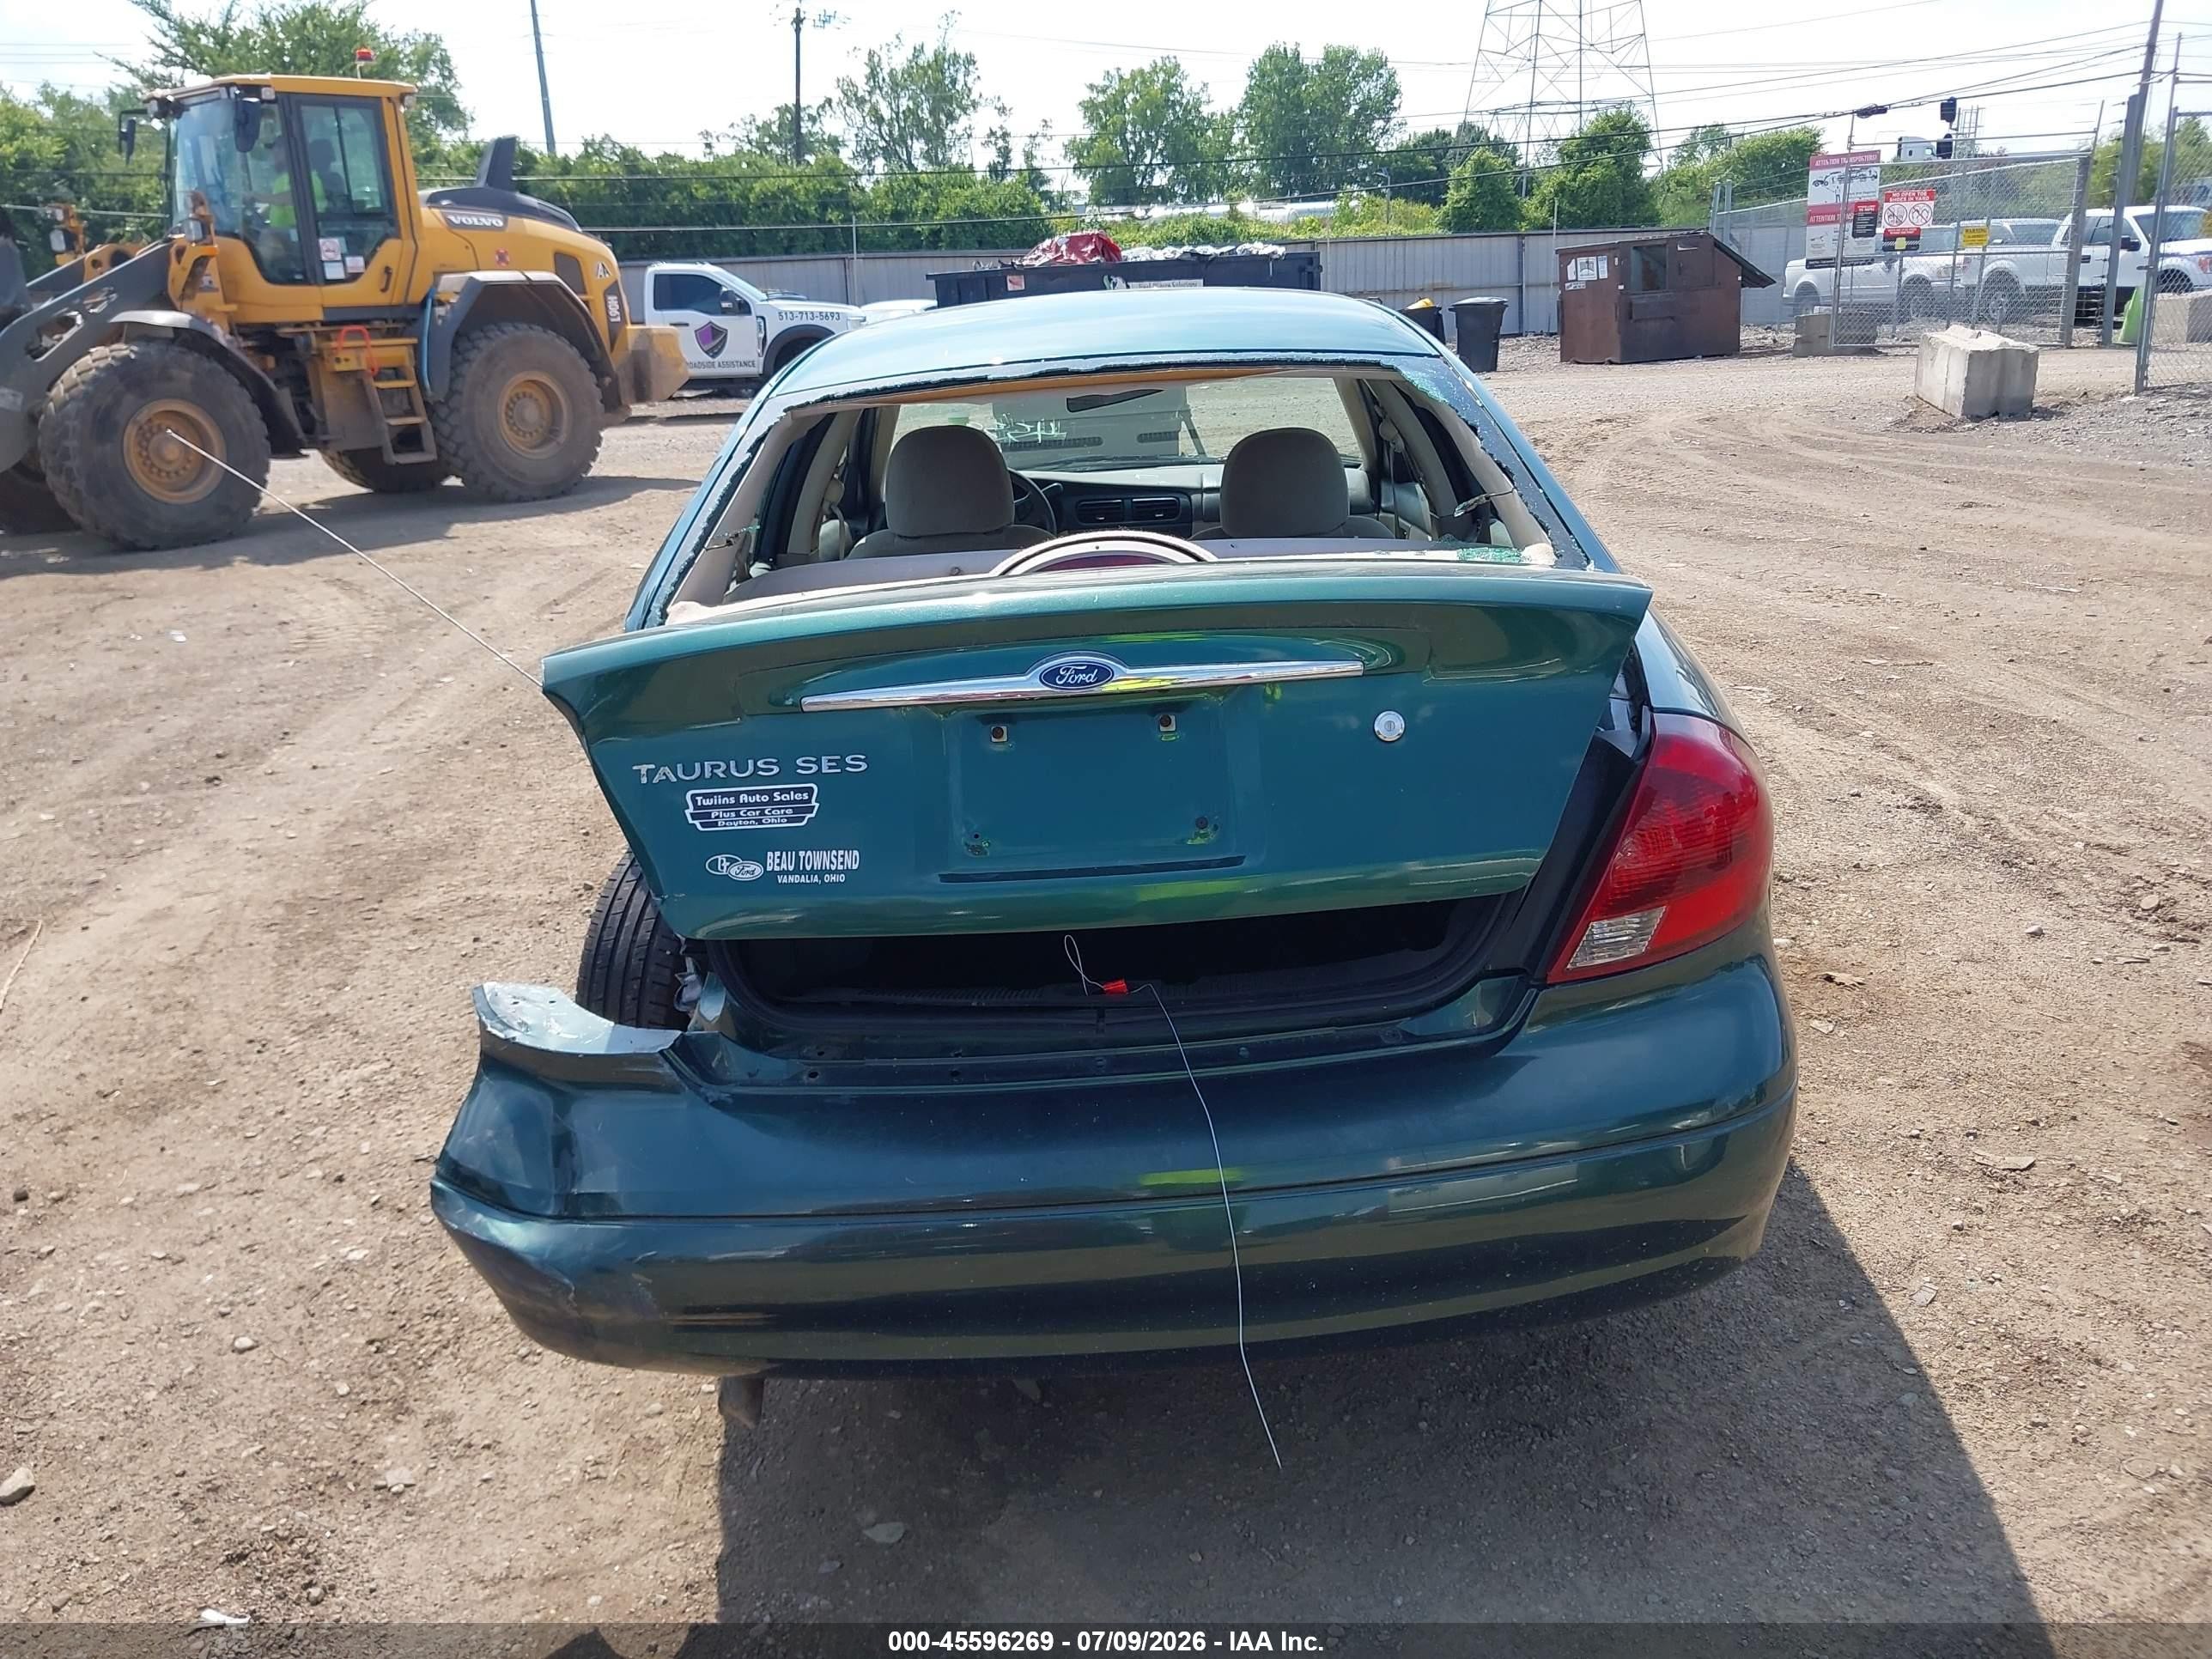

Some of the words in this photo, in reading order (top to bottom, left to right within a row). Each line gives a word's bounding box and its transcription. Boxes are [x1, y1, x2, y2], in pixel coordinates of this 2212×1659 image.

[1814, 158, 1839, 167] ATTENTION
[447, 215, 504, 228] VOLVO
[606, 295, 621, 322] L90H
[778, 312, 841, 321] 513-713-5693
[718, 360, 757, 368] ASSISTANCE
[1055, 665, 1098, 685] Ford
[632, 757, 780, 784] TAURUS
[795, 754, 869, 775] SES
[695, 794, 735, 806] Twiins
[738, 793, 769, 804] Auto
[773, 790, 809, 802] Sales
[710, 810, 736, 819] Plus
[739, 808, 761, 817] Car
[764, 807, 793, 816] Care
[717, 817, 759, 827] Dayton,
[766, 851, 795, 872] BEAU
[799, 849, 860, 871] TOWNSEND
[734, 865, 757, 876] Ford
[777, 874, 822, 884] VANDALIA,
[823, 873, 846, 883] OHIO
